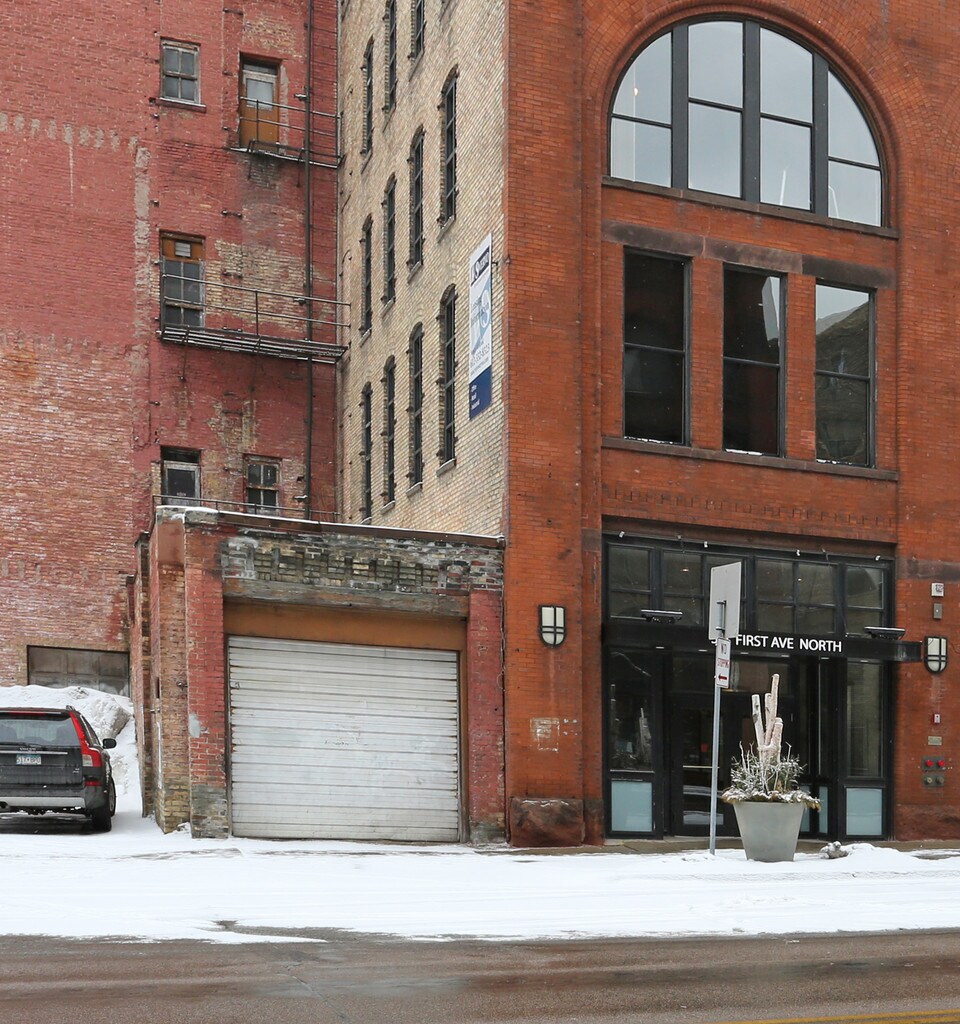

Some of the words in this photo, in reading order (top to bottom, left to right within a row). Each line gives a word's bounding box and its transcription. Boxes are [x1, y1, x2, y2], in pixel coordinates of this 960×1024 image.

[735, 634, 769, 647] FIRST
[771, 637, 794, 650] AVE
[799, 638, 842, 653] NORTH
